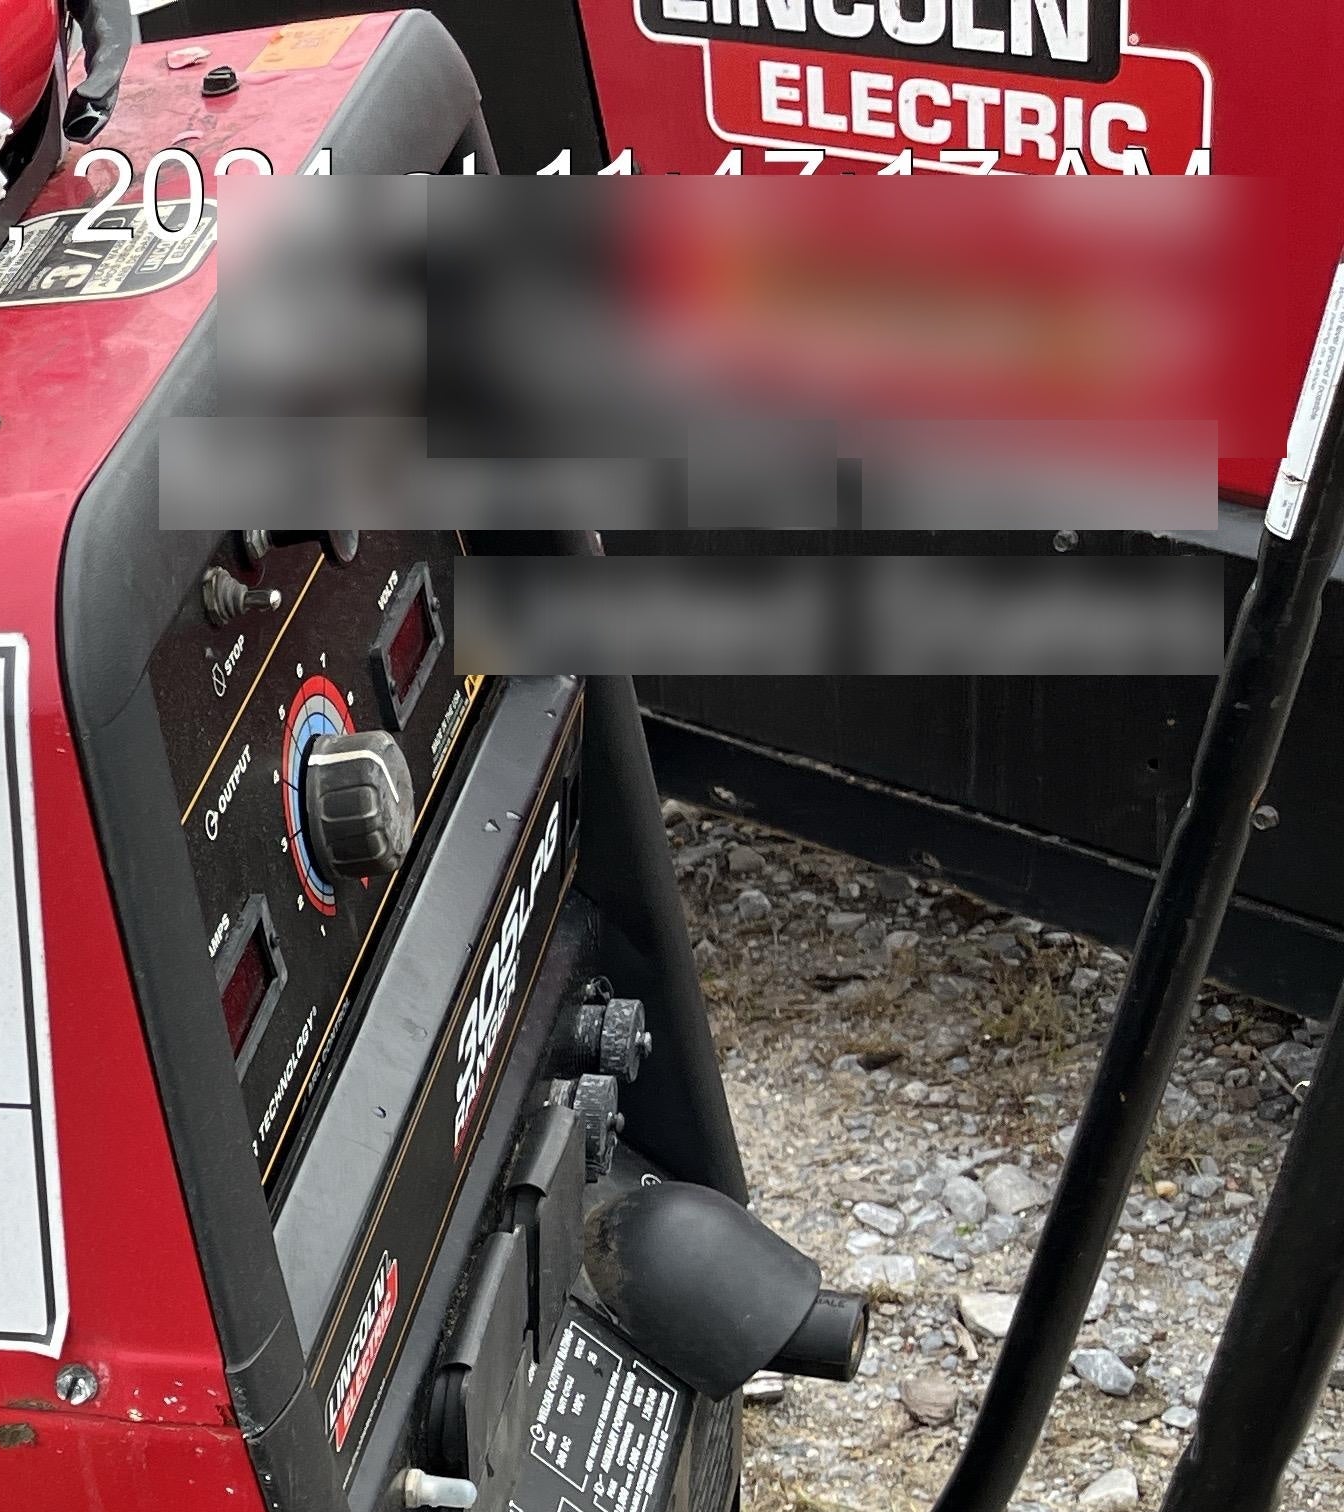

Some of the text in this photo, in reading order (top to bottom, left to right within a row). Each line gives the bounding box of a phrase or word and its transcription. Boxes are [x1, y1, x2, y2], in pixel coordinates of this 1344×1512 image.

[758, 59, 1150, 172] ELECTRIC
[376, 570, 400, 611] VOLTS
[223, 634, 247, 678] STOP
[216, 743, 253, 816] OUTPUT
[258, 1015, 313, 1142] TECHNOLOGY
[453, 949, 520, 1150] RANGER
[329, 1265, 386, 1431] LINCOLN
